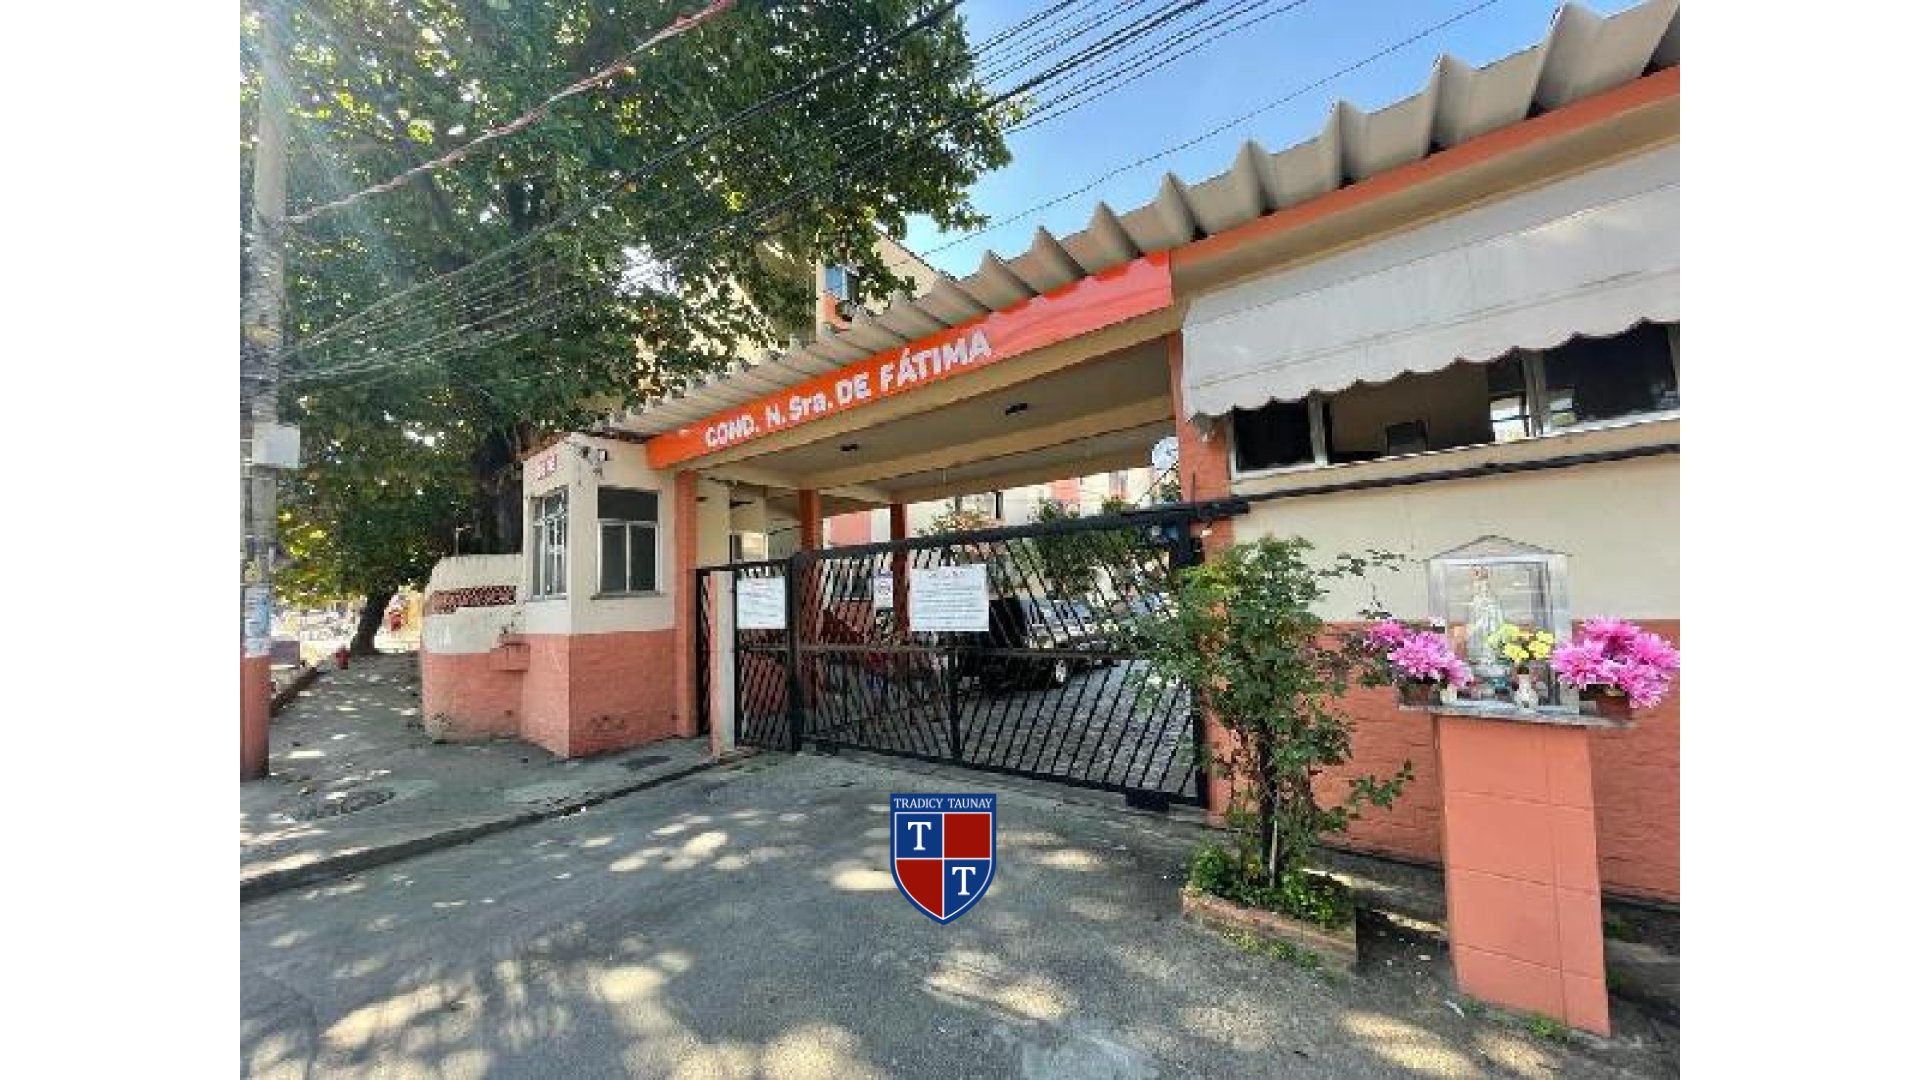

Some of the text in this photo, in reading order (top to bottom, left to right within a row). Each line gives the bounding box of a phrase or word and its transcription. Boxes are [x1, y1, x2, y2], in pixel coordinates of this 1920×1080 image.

[705, 329, 992, 447] COND. N. Sra. DE FÁTIMA
